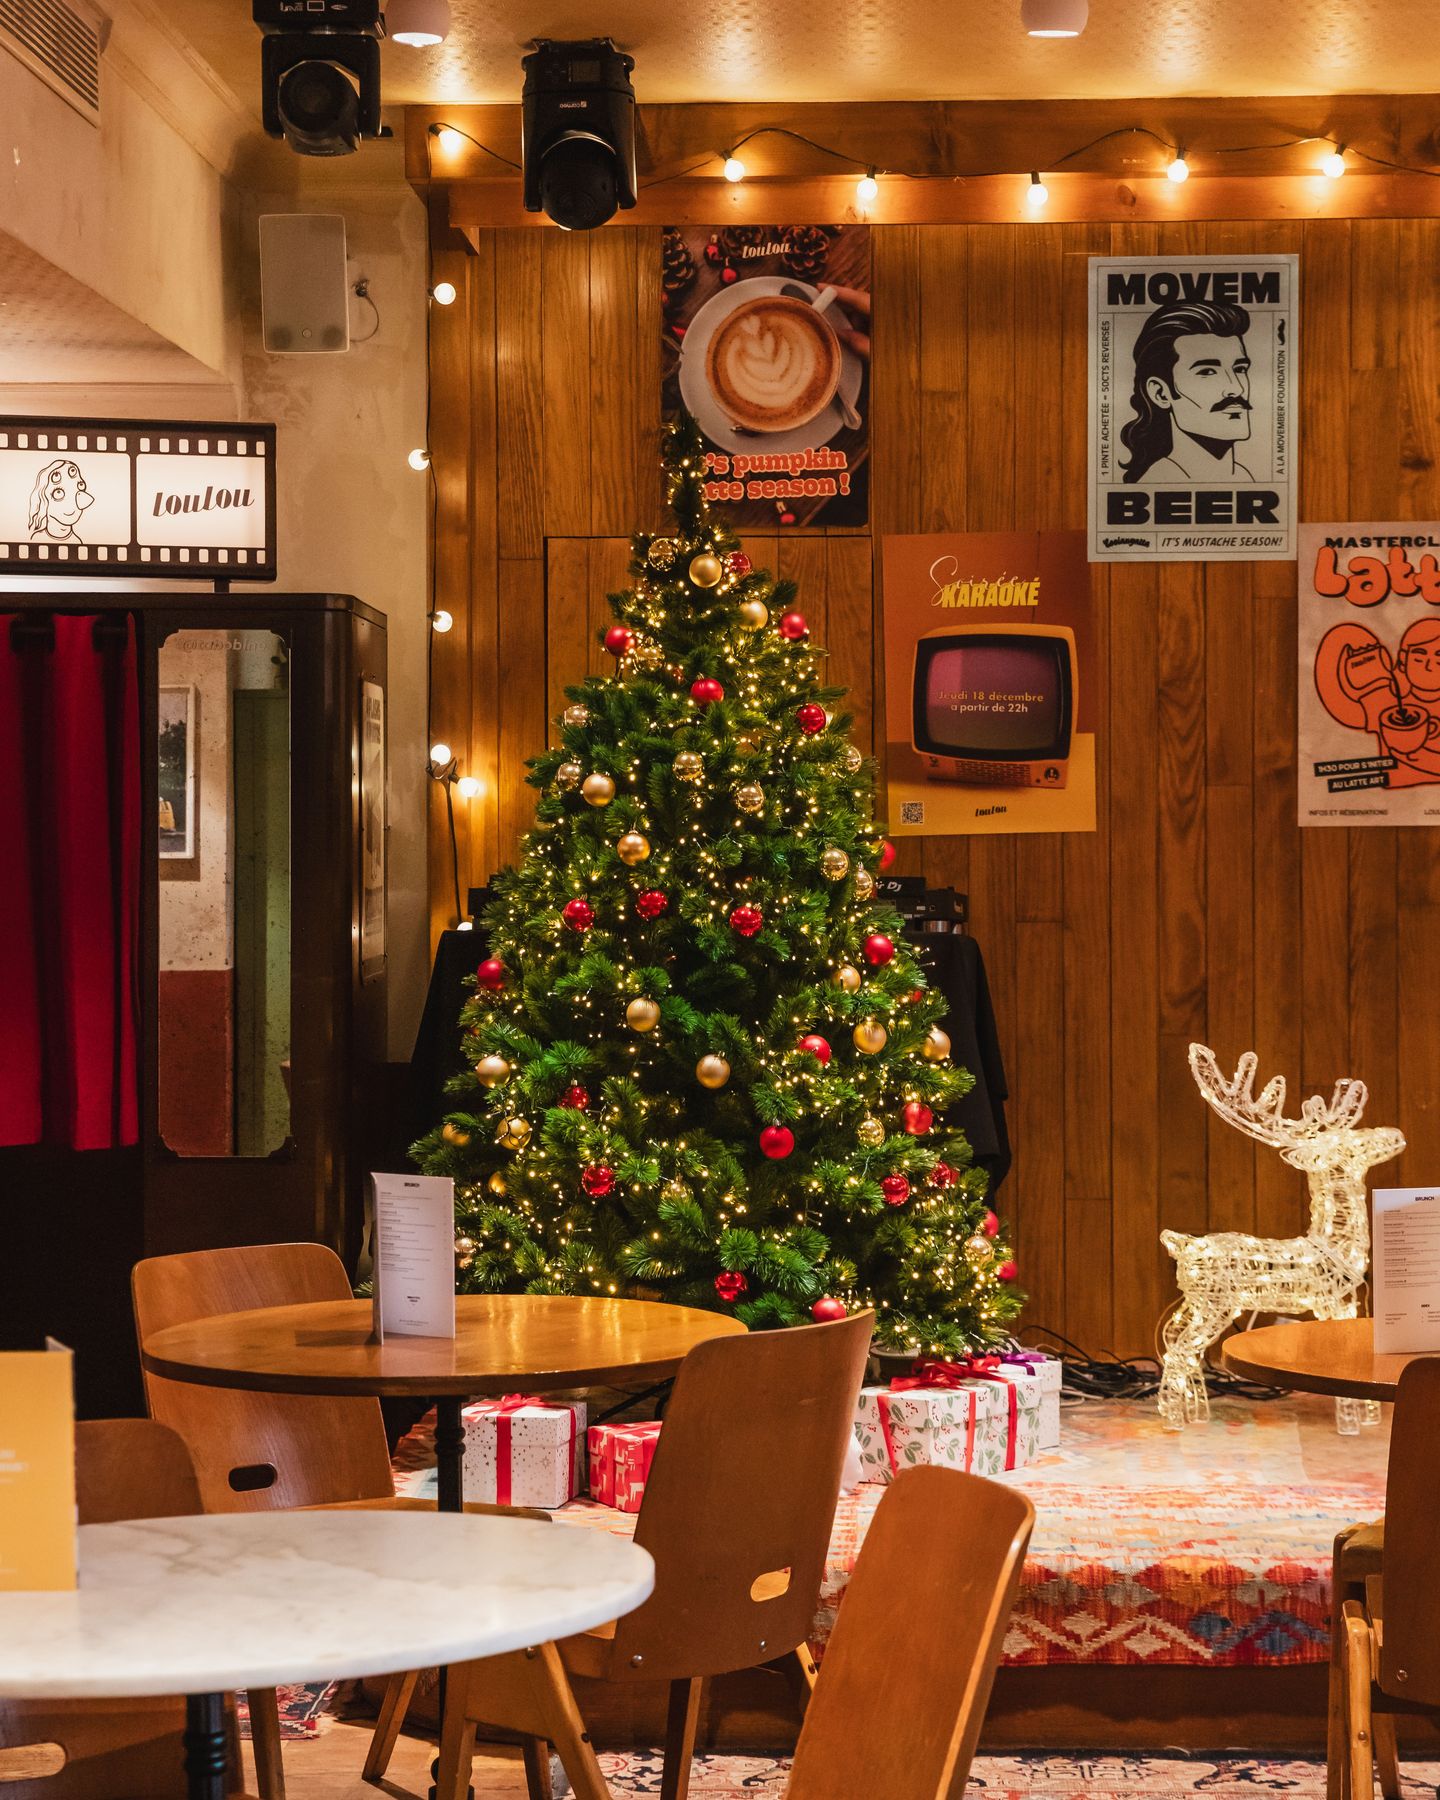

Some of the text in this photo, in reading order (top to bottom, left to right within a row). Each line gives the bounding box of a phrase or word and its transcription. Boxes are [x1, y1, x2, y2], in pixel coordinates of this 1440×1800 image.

[1107, 272, 1280, 306] MOVEM
[1277, 350, 1286, 403] FOUNDATION
[1277, 406, 1285, 455] MOVEMBER
[732, 446, 848, 478] pumpkin
[1101, 443, 1109, 468] PINTE
[1277, 455, 1285, 466] LA
[747, 477, 837, 500] season
[152, 486, 256, 517] loulou
[1107, 490, 1280, 525] BEER
[1161, 536, 1283, 547] IT'S MUSTACHE SEASON!
[1325, 536, 1440, 548] MASTERCL
[941, 577, 1040, 608] KARAOKÉ
[939, 690, 968, 700] Jeudi
[973, 691, 985, 701] 18
[960, 702, 989, 714] partir
[992, 703, 1005, 712] de
[1008, 703, 1028, 713] 22h
[1339, 762, 1360, 771] POUR
[1344, 778, 1368, 788] LATTE
[1370, 776, 1385, 785] ART
